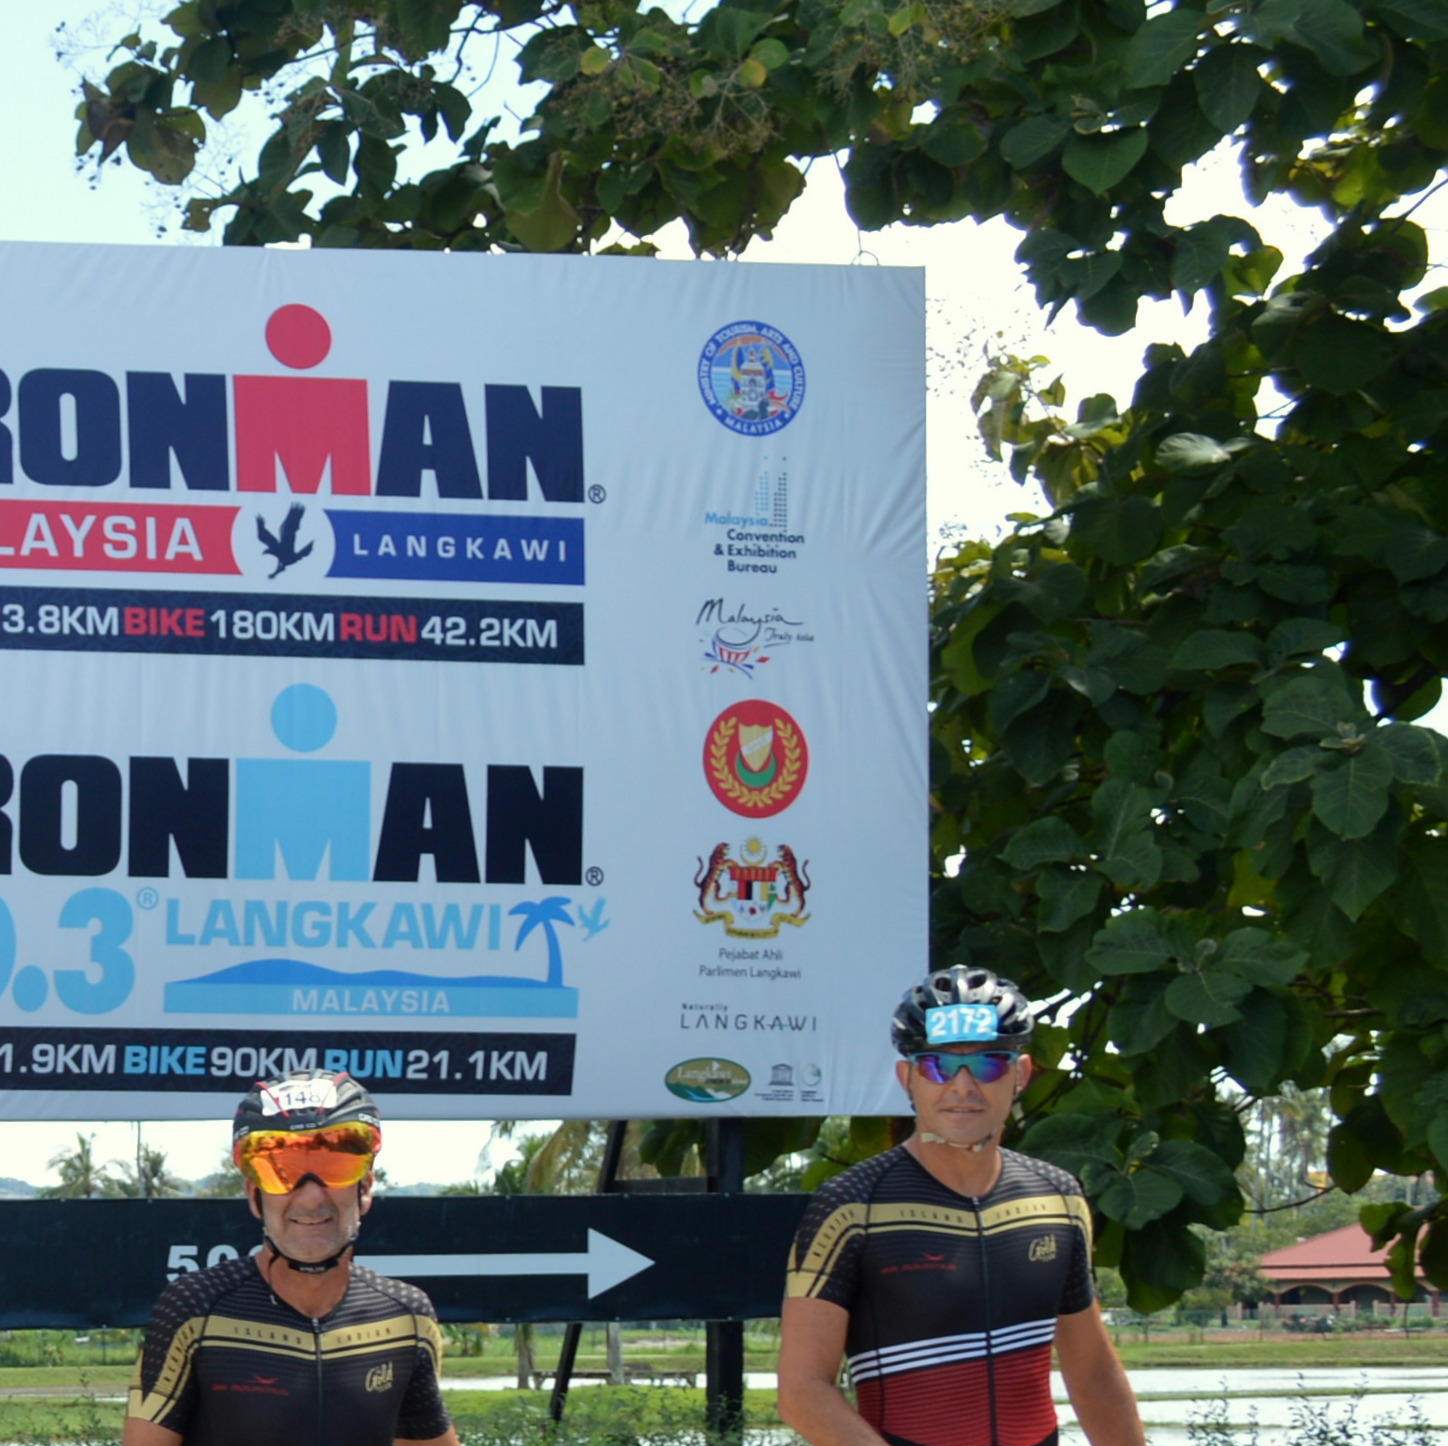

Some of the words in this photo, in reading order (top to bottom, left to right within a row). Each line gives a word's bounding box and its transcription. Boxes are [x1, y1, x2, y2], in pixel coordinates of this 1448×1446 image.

[725, 416, 782, 433] MALAYSIA
[705, 511, 768, 528] Malaysia
[727, 528, 805, 544] Convention
[352, 533, 566, 564] LANGKAWI
[714, 544, 724, 556] &
[727, 544, 797, 559] Exhibition
[727, 559, 777, 574] Bureau
[696, 597, 803, 634] Malaysia
[2, 603, 119, 636] 3.8KM
[124, 608, 205, 637] BIKE
[210, 610, 335, 641] 180KM
[339, 612, 417, 642] RUN
[421, 616, 558, 648] 42.2KM
[163, 898, 501, 950] LANGKAWI
[719, 947, 759, 961] Pejabat
[699, 965, 747, 978] Parlimen
[749, 967, 801, 981] Langkawi
[293, 989, 450, 1014] MALAYSIA
[680, 1013, 817, 1031] LANGKAWI
[930, 1007, 995, 1038] 2172
[123, 1045, 206, 1075] BIKE
[209, 1046, 318, 1077] 90KM
[323, 1048, 403, 1078] RUN
[406, 1050, 548, 1081] 21.1KM
